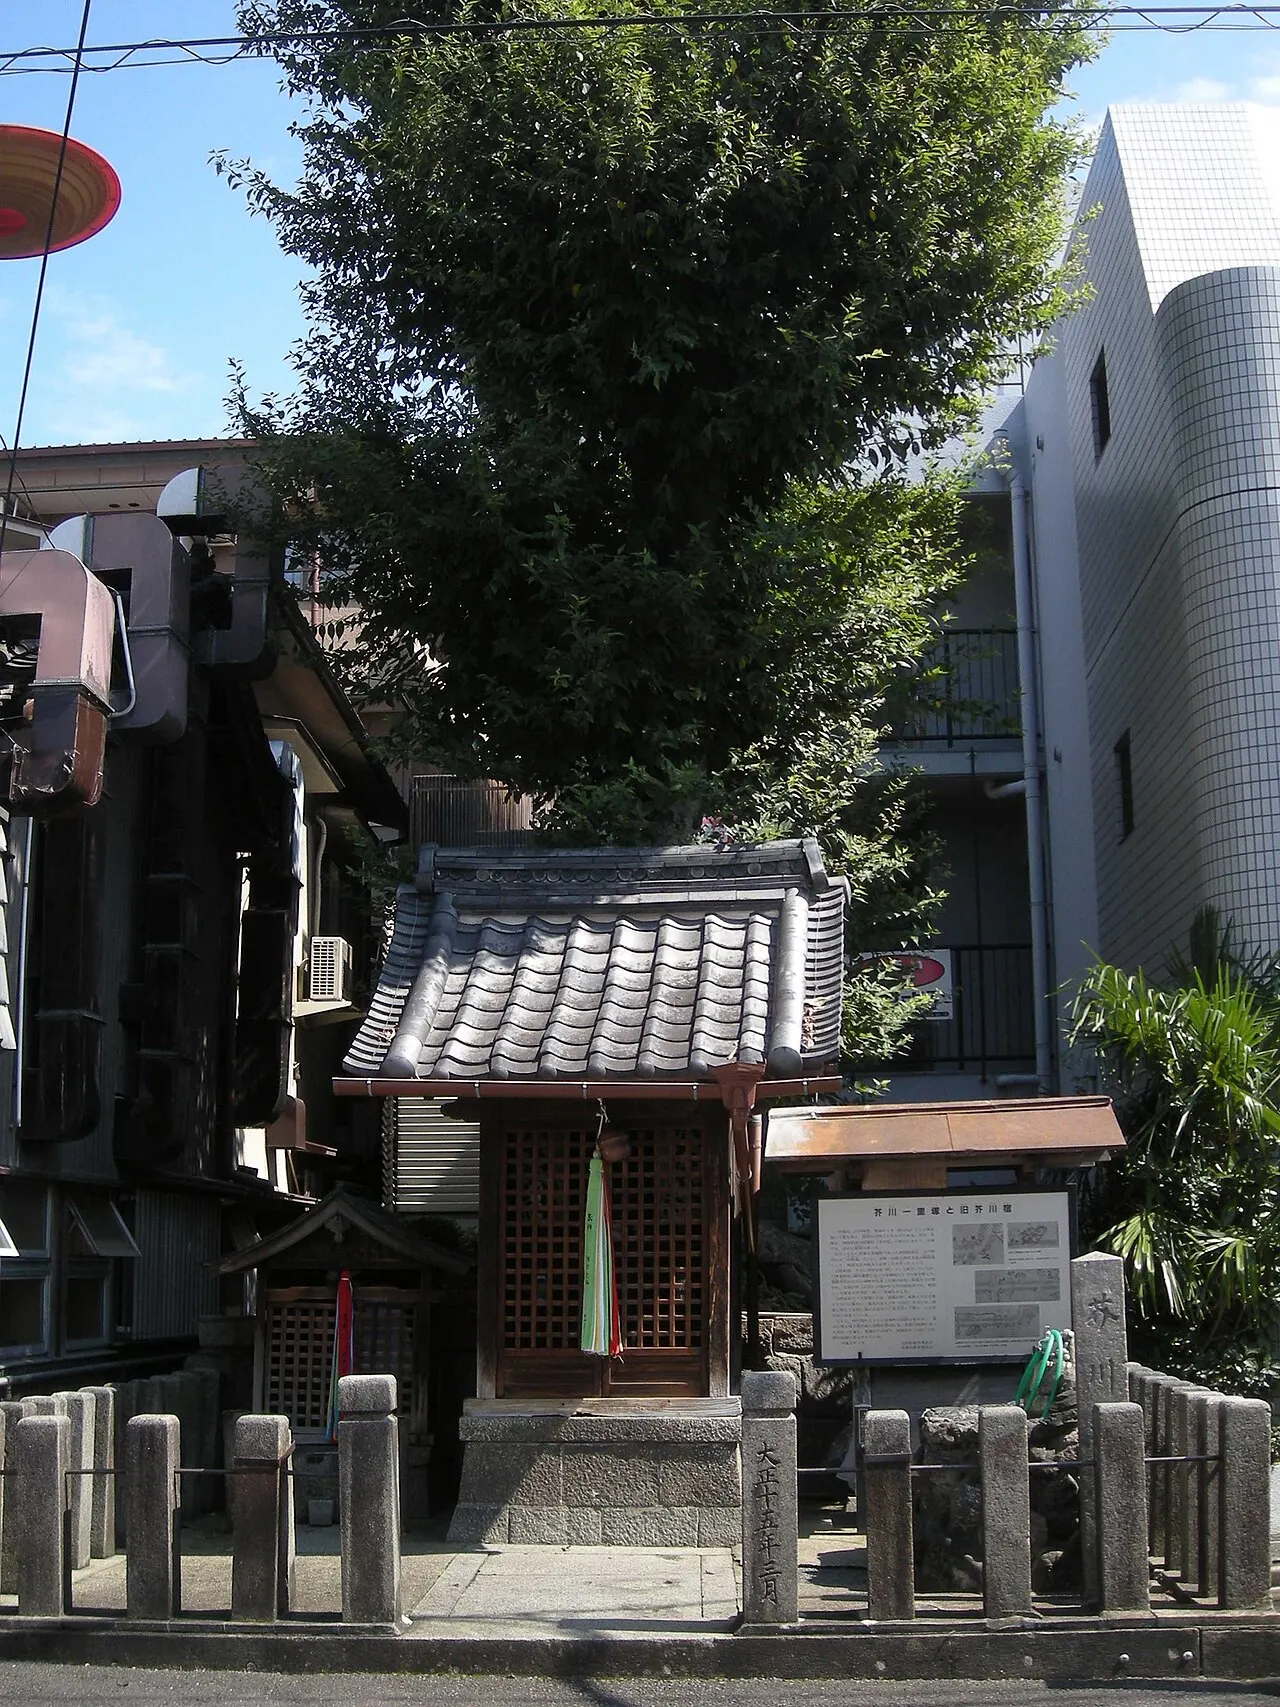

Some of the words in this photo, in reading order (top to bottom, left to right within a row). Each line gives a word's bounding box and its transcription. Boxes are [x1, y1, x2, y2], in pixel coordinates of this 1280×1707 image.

[873, 1204, 1012, 1217] 芥川一里塚と旧芥川宿
[754, 1441, 782, 1605] 大正十五年三月
